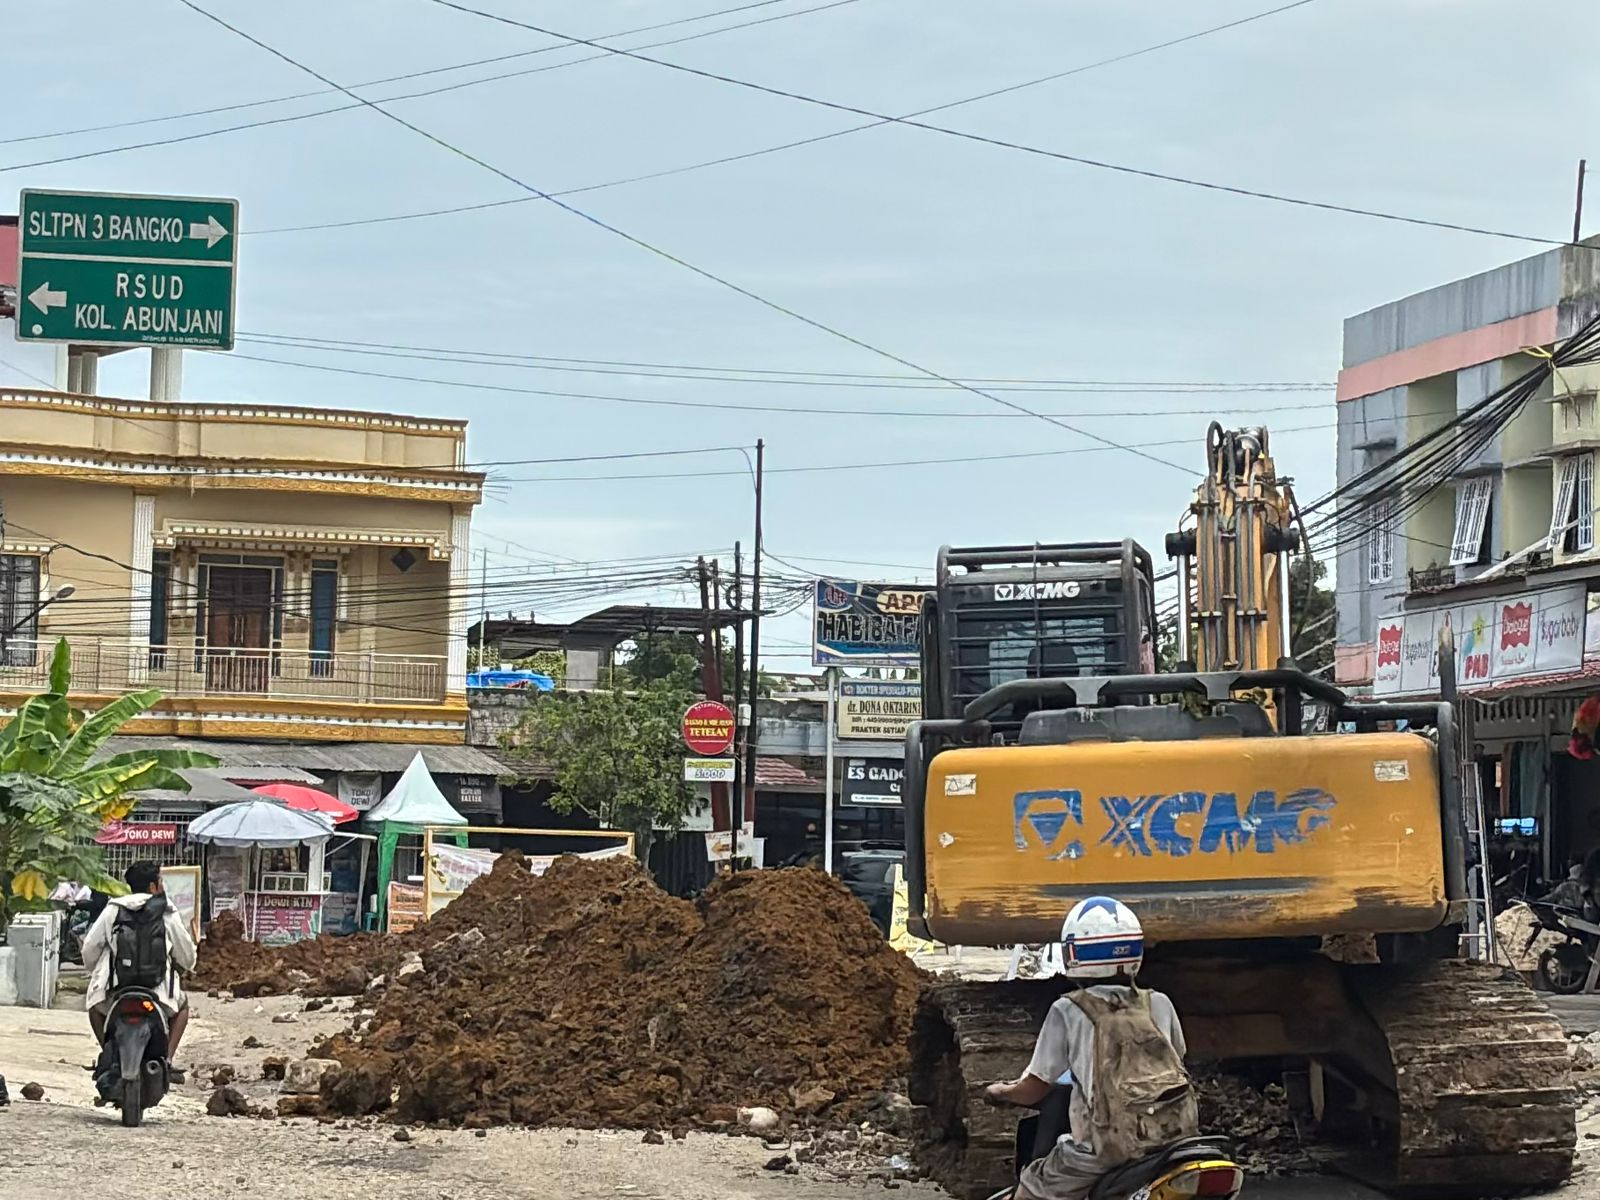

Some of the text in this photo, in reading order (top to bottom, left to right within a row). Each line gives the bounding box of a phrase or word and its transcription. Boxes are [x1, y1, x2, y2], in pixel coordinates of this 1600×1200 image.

[29, 211, 184, 243] SLTPN 3 BANGKO
[116, 273, 184, 300] RSUD
[75, 304, 223, 335] KOL. ABUNJANI
[1013, 581, 1080, 600] XCMG
[818, 611, 897, 642] HABIBA
[860, 700, 881, 713] DONA
[689, 727, 729, 737] TETELAN
[848, 766, 865, 780] ES
[1098, 788, 1337, 857] XCMG
[125, 829, 175, 840] TOKO DEWI
[264, 895, 290, 907] Dewi
